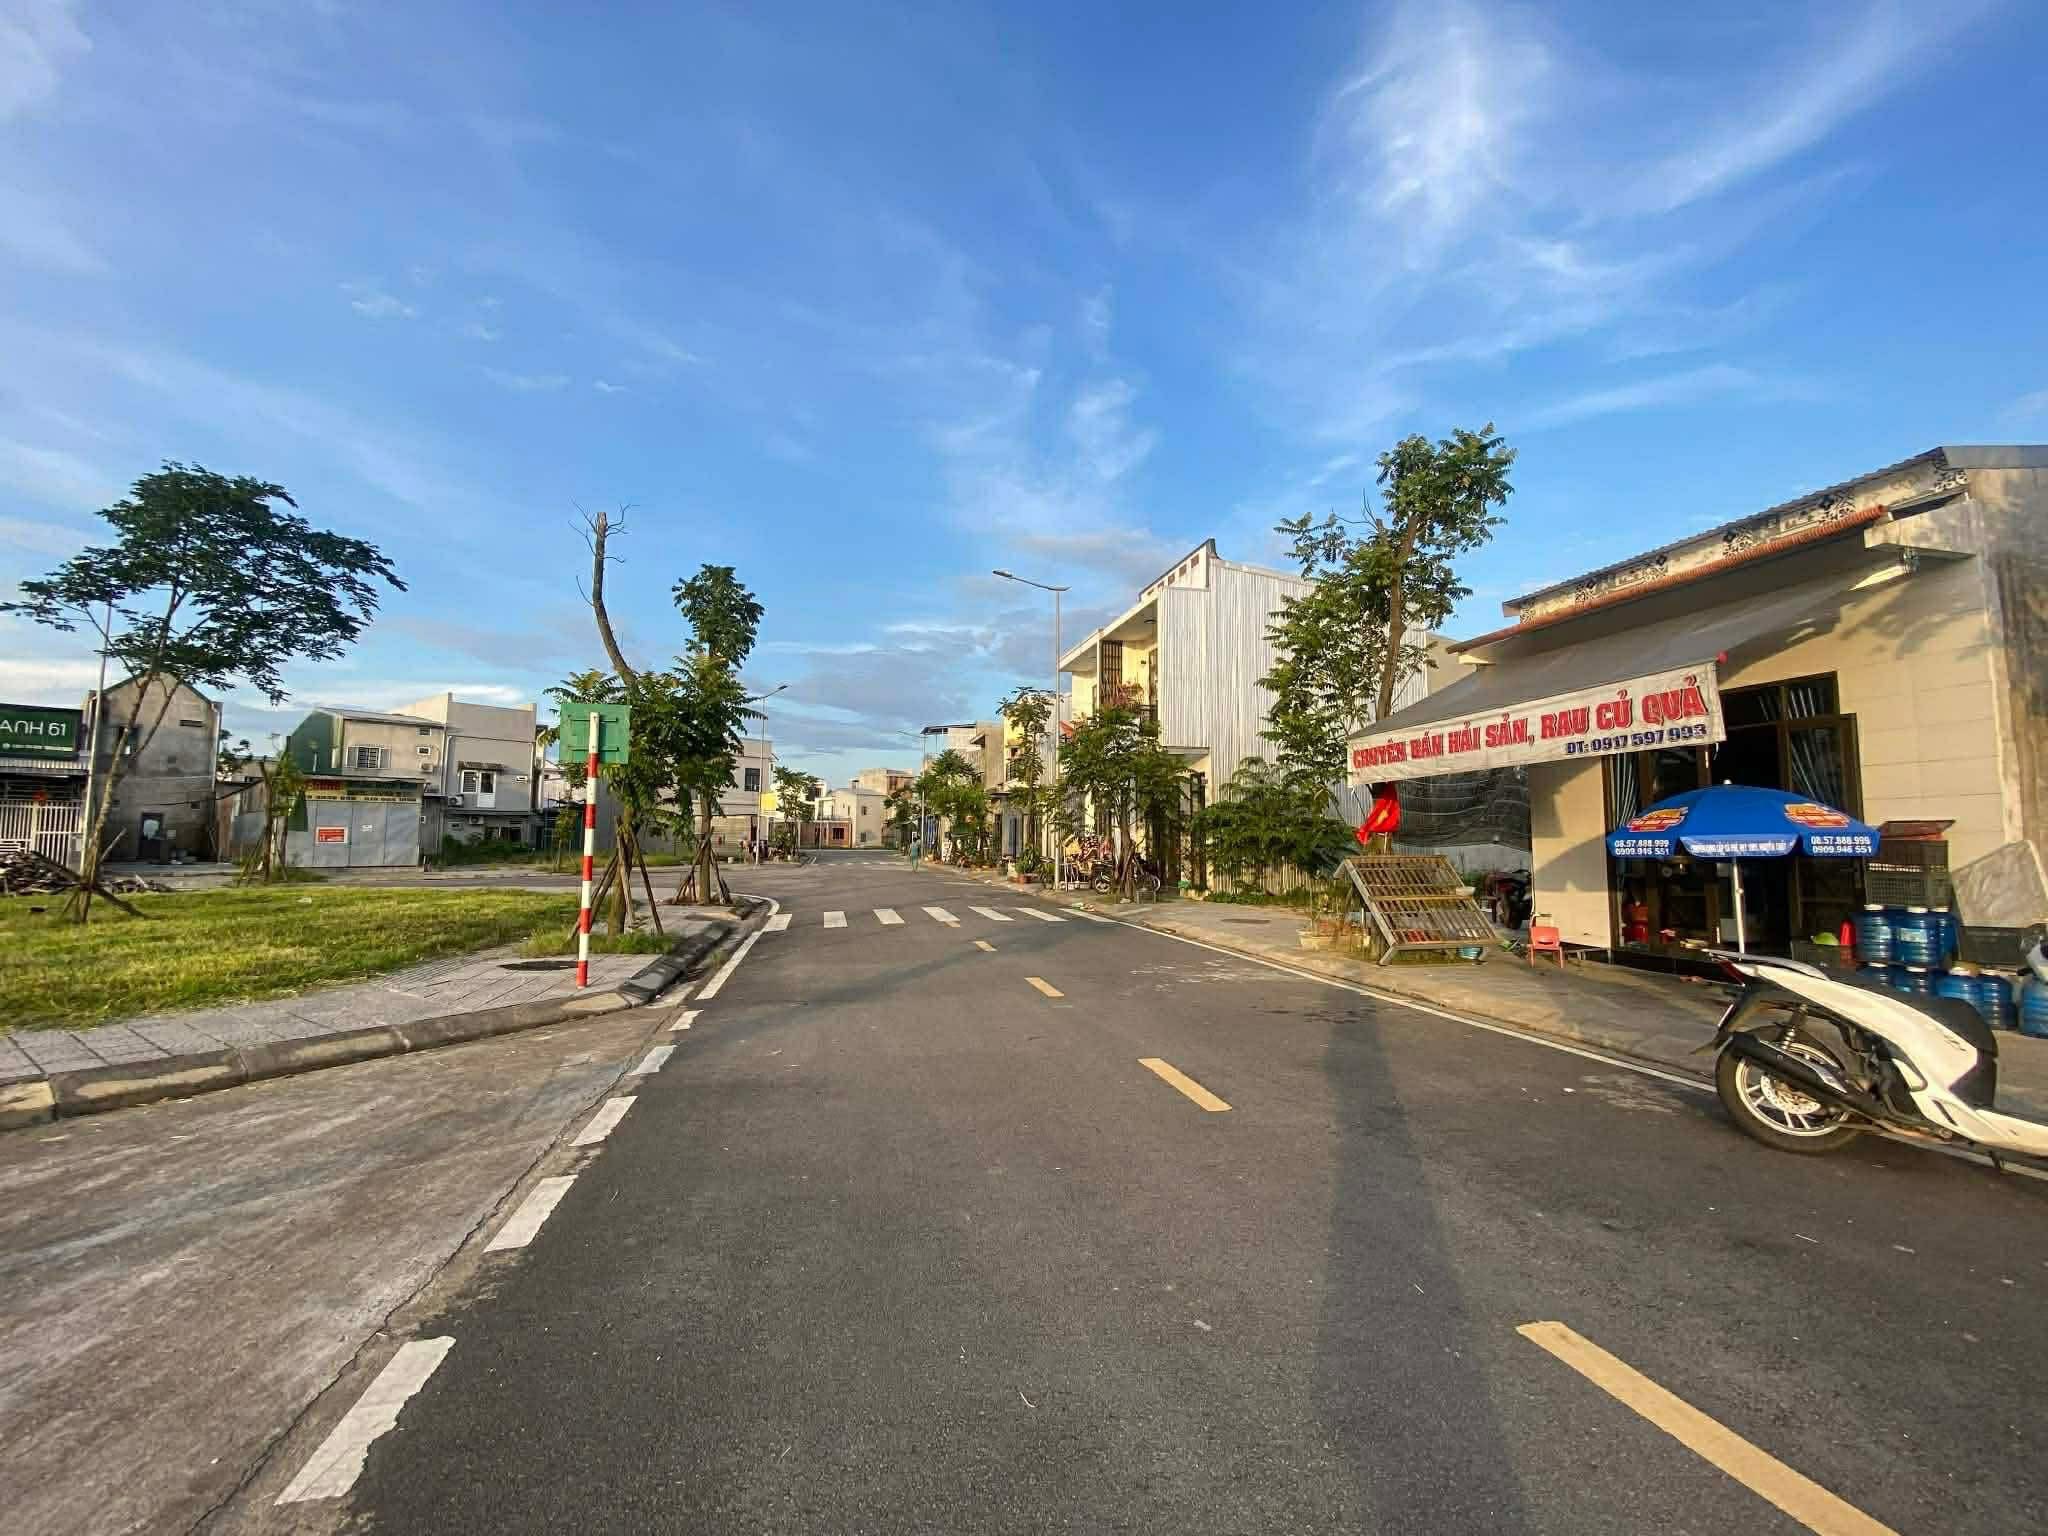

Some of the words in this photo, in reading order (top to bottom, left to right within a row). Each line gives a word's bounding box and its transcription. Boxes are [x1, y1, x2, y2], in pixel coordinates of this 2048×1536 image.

[48, 721, 67, 737] 61
[1448, 720, 1481, 754] HẢI
[1486, 712, 1535, 748] SẢN,
[1541, 706, 1590, 739] RAU
[1596, 688, 1633, 730] CỦ
[1641, 674, 1709, 726] QUẢ
[1591, 735, 1628, 753] 0917
[1631, 729, 1665, 746] 597
[1668, 723, 1707, 742] 993
